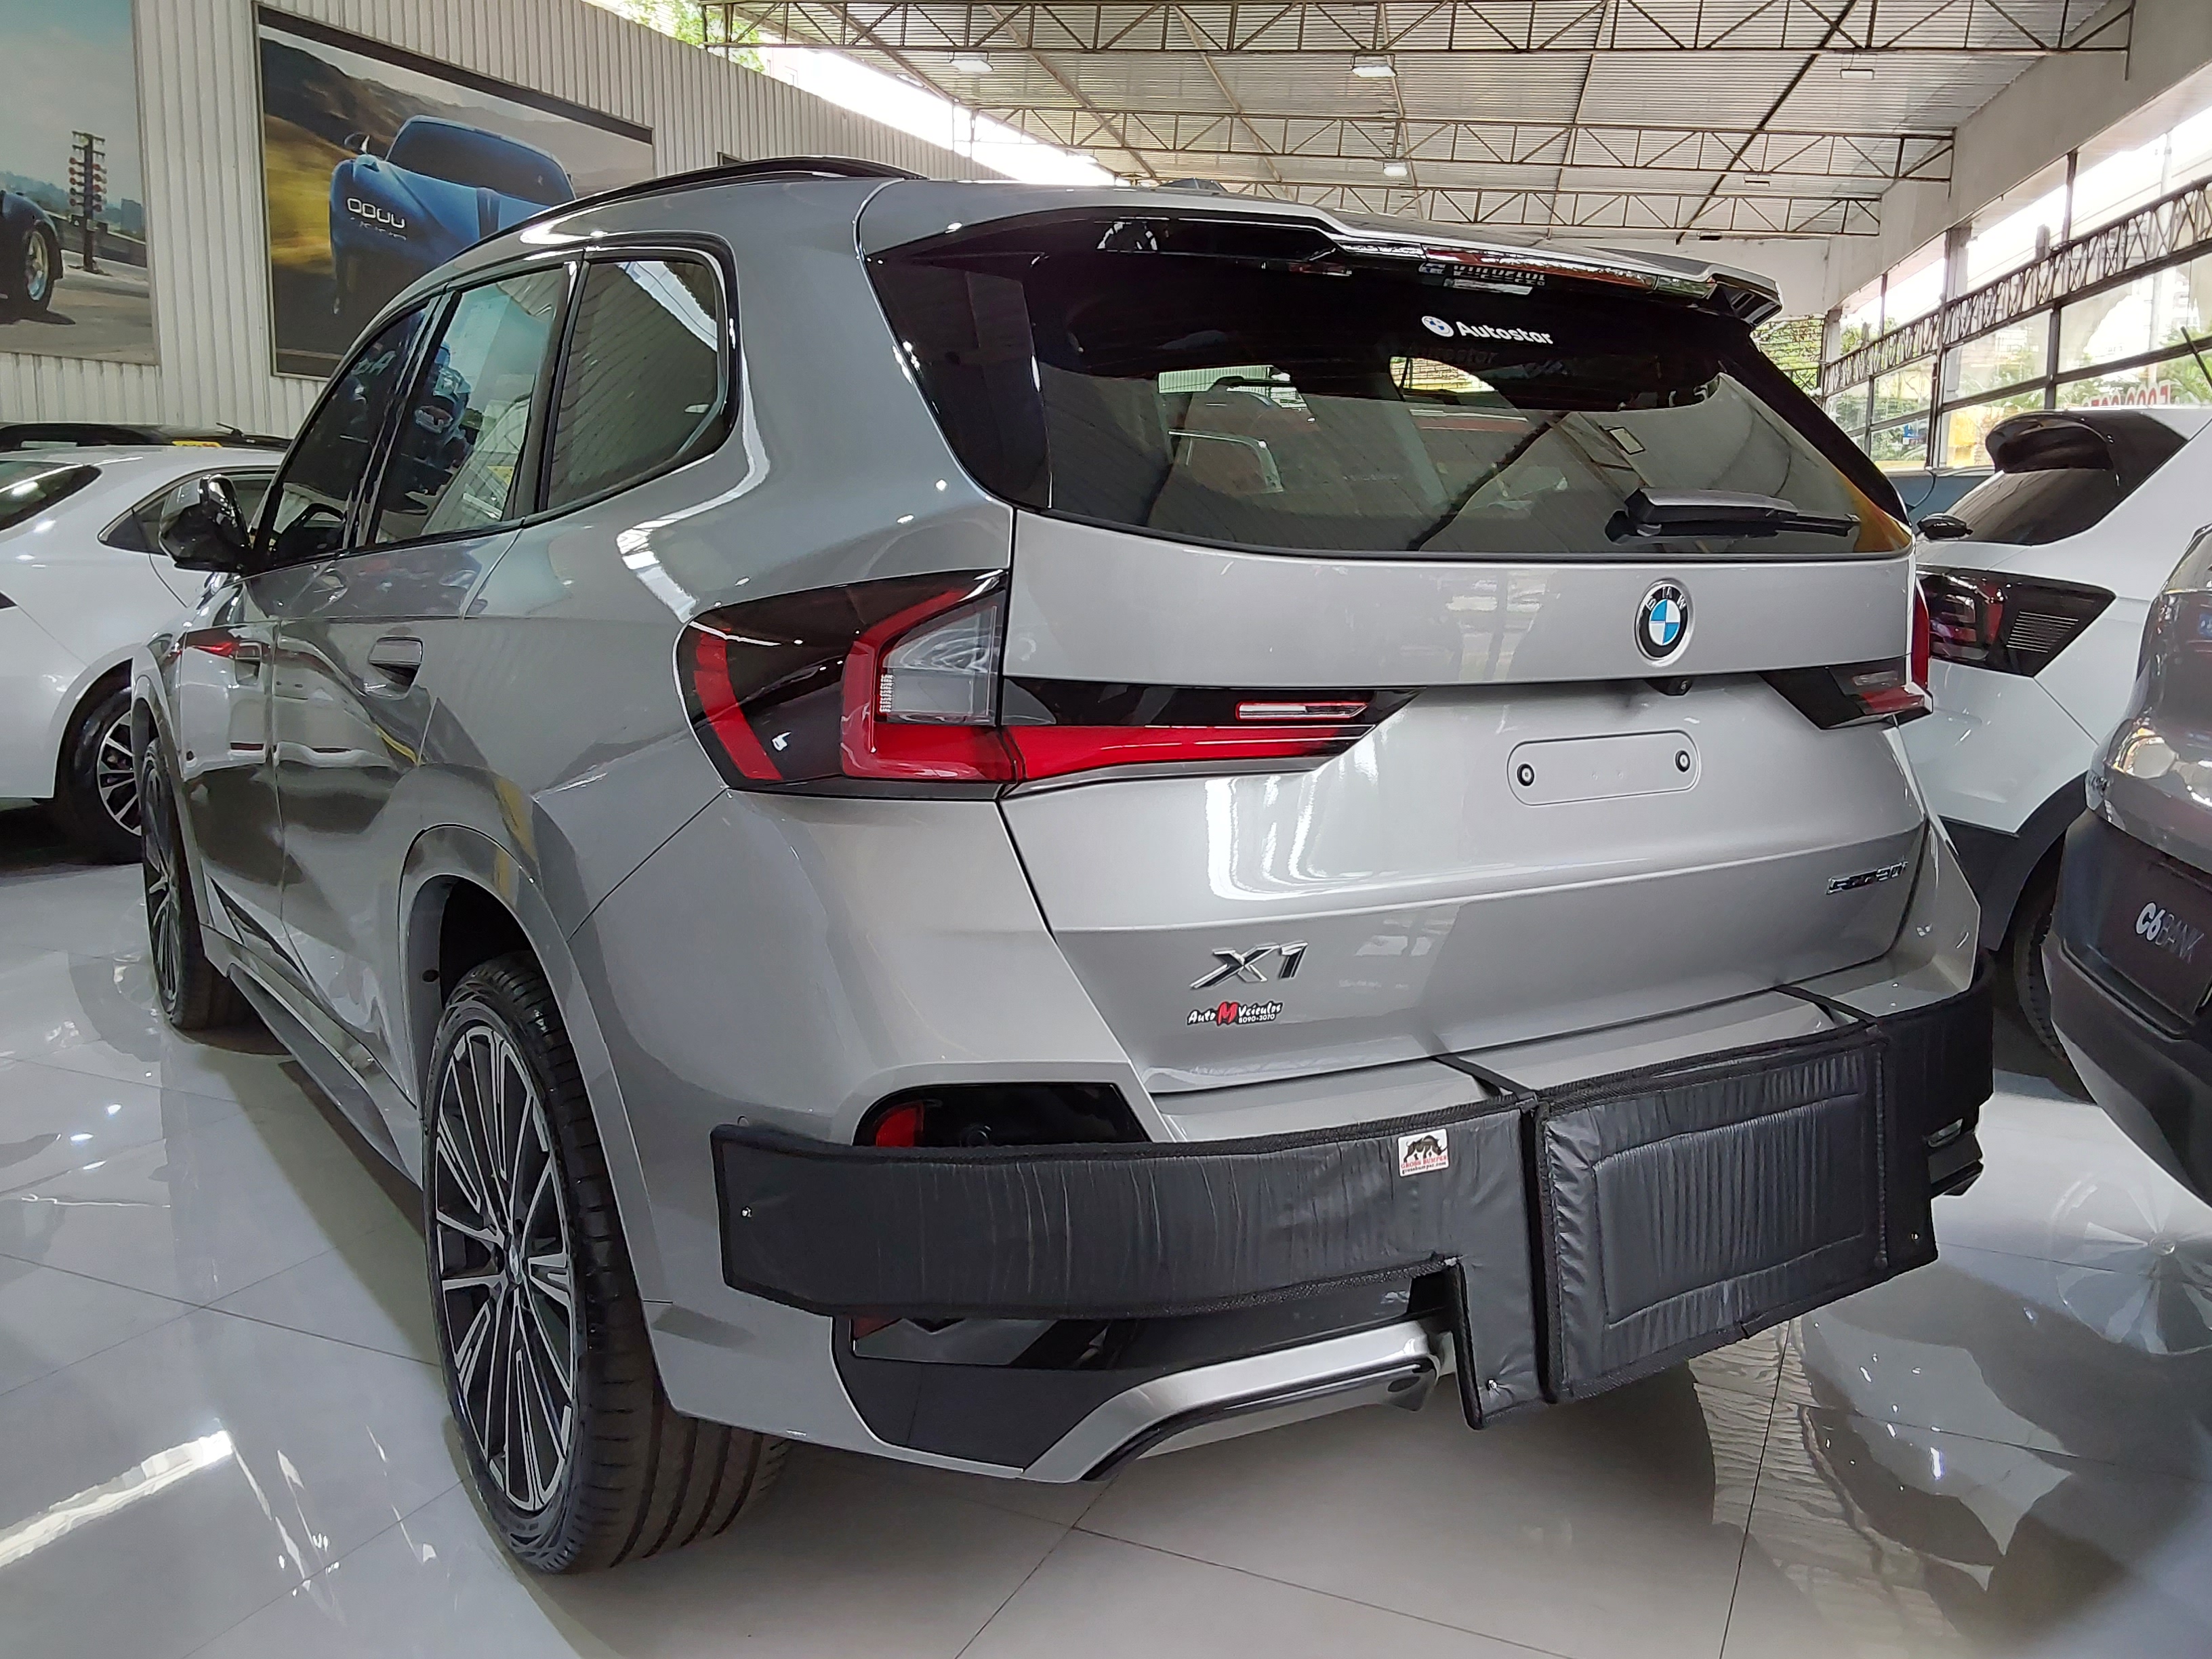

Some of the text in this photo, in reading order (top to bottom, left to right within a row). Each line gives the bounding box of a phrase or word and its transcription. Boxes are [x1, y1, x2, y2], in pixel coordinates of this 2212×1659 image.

[1455, 321, 1553, 345] Autostar
[1645, 586, 1687, 611] BMW
[1189, 939, 1309, 989] X1
[1187, 1010, 1216, 1024] Auto
